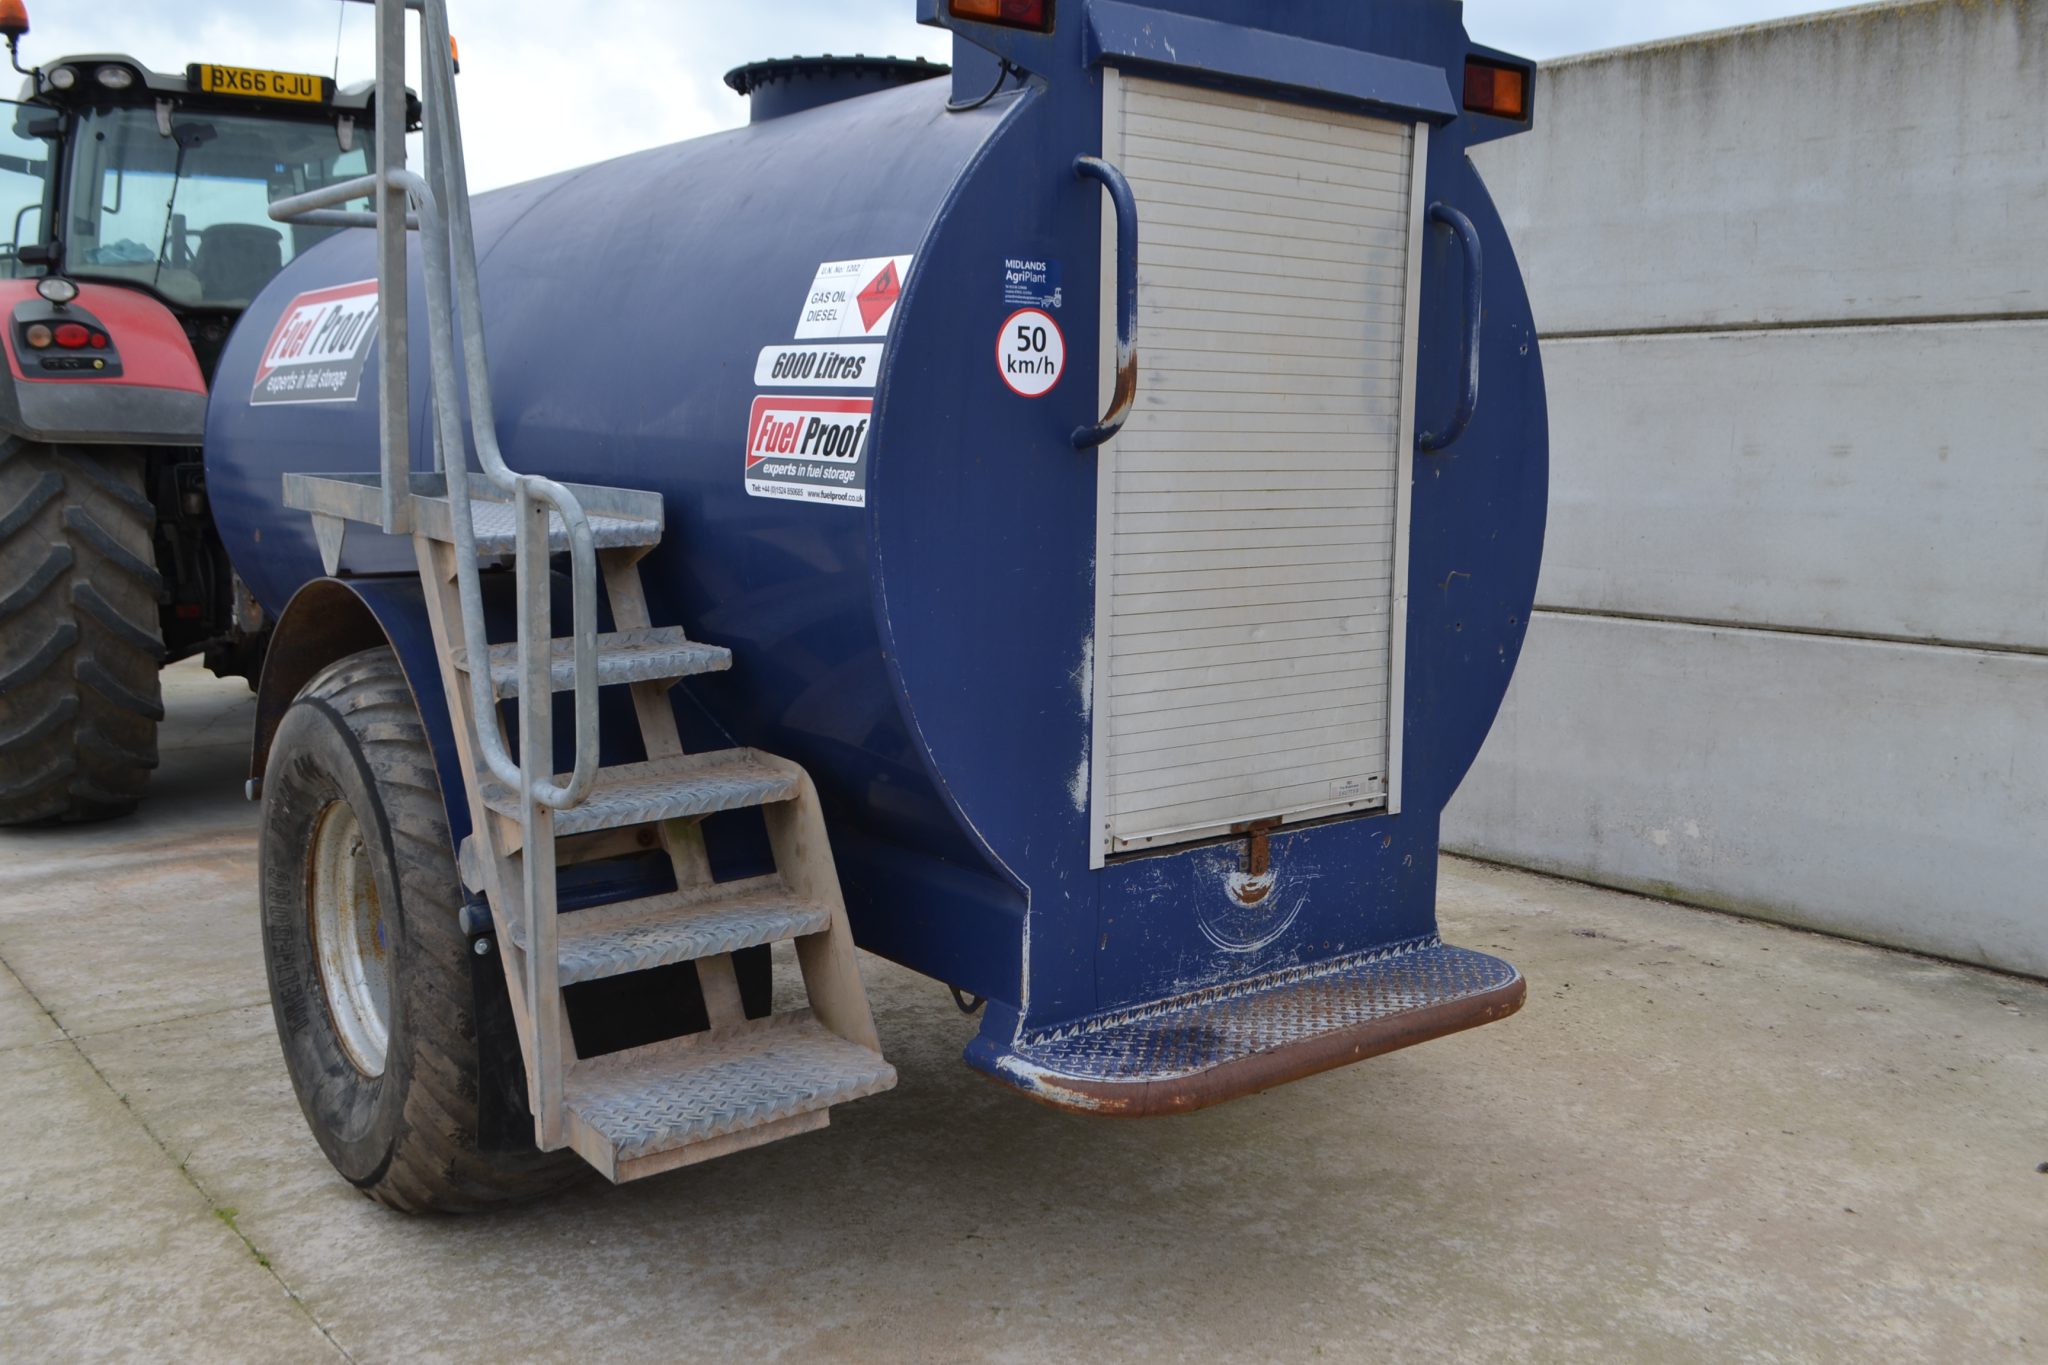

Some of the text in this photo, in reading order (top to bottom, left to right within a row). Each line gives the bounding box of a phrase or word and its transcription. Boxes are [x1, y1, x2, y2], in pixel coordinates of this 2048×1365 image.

[212, 69, 312, 96] BX66 GJU
[846, 263, 861, 273] 1202
[1005, 259, 1046, 271] MIDLANDS
[1005, 270, 1046, 284] AgriPlant
[811, 291, 846, 304] GAS OIL
[806, 309, 838, 322] DIESEL
[270, 300, 379, 359] Fuel Proof
[1017, 325, 1047, 352] 50
[771, 351, 866, 379] 6000 Litres
[1007, 353, 1055, 375] km/h
[266, 368, 347, 394] experts in fuel storage
[755, 415, 868, 458] Fuel Proof
[762, 463, 856, 483] experts in fuel storage
[807, 489, 864, 503] www.fuelproof.co.uk
